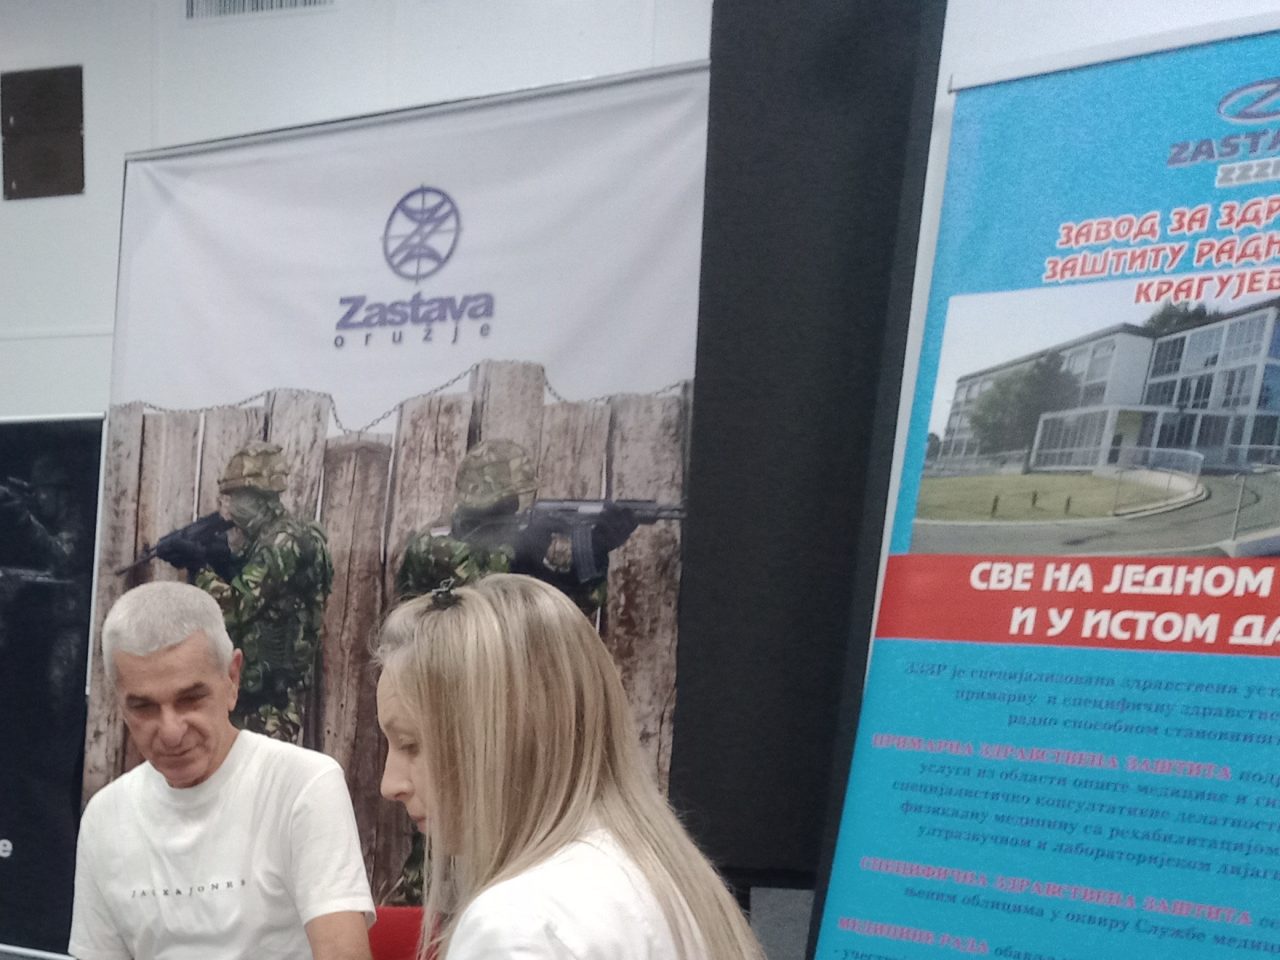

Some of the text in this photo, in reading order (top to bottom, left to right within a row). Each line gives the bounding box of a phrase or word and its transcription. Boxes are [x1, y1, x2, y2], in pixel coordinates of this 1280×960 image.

[1060, 197, 1280, 247] ЗАВОД ЗА ЗДР
[1045, 243, 1185, 281] ЗАШТИТУ
[1134, 268, 1280, 303] КРАГУЈЕВ
[334, 291, 495, 330] Zastava
[970, 562, 1274, 598] СВЕ НА ЈЕДНОМ
[1009, 607, 1037, 634] И
[1046, 608, 1073, 636] У
[1080, 609, 1220, 644] ИСТОМ
